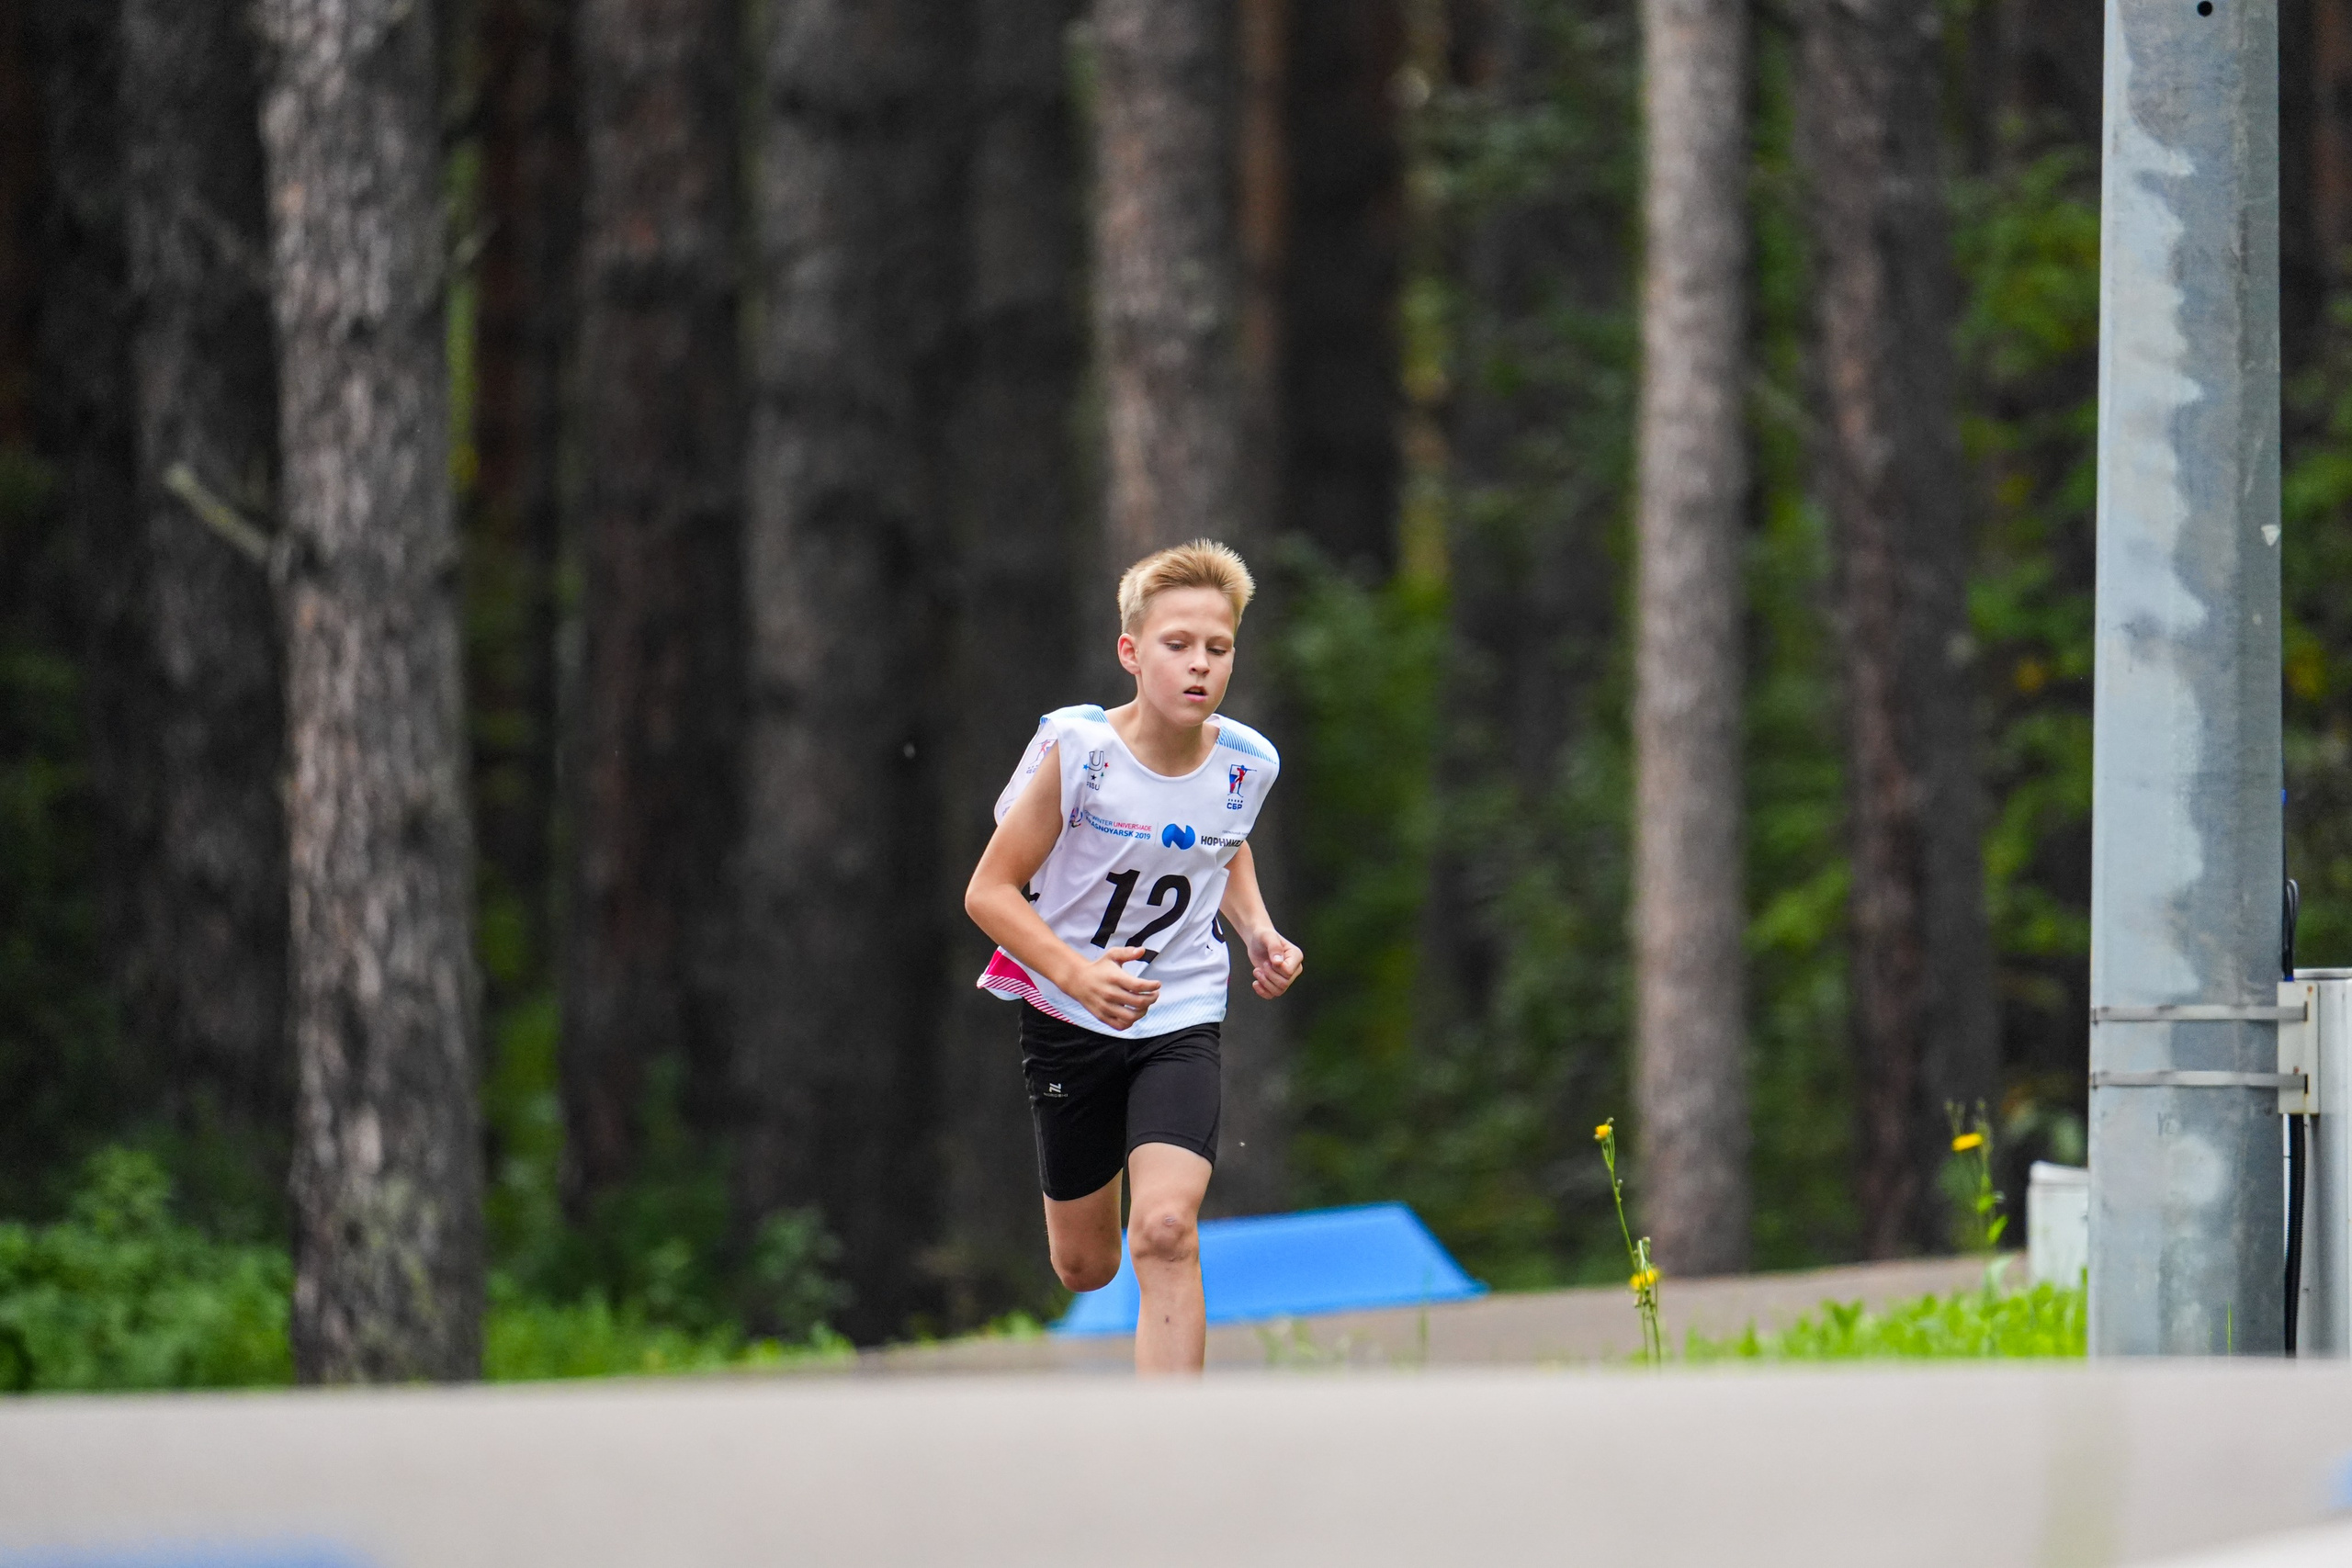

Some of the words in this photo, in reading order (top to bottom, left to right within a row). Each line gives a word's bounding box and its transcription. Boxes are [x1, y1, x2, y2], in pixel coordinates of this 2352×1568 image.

[1086, 781, 1101, 791] FISU
[1227, 802, 1243, 810] СБР
[1092, 815, 1114, 827] WINTER
[1114, 821, 1152, 832] UNIVERSIADE
[1134, 831, 1151, 840] 2019
[1091, 869, 1192, 964] 12
